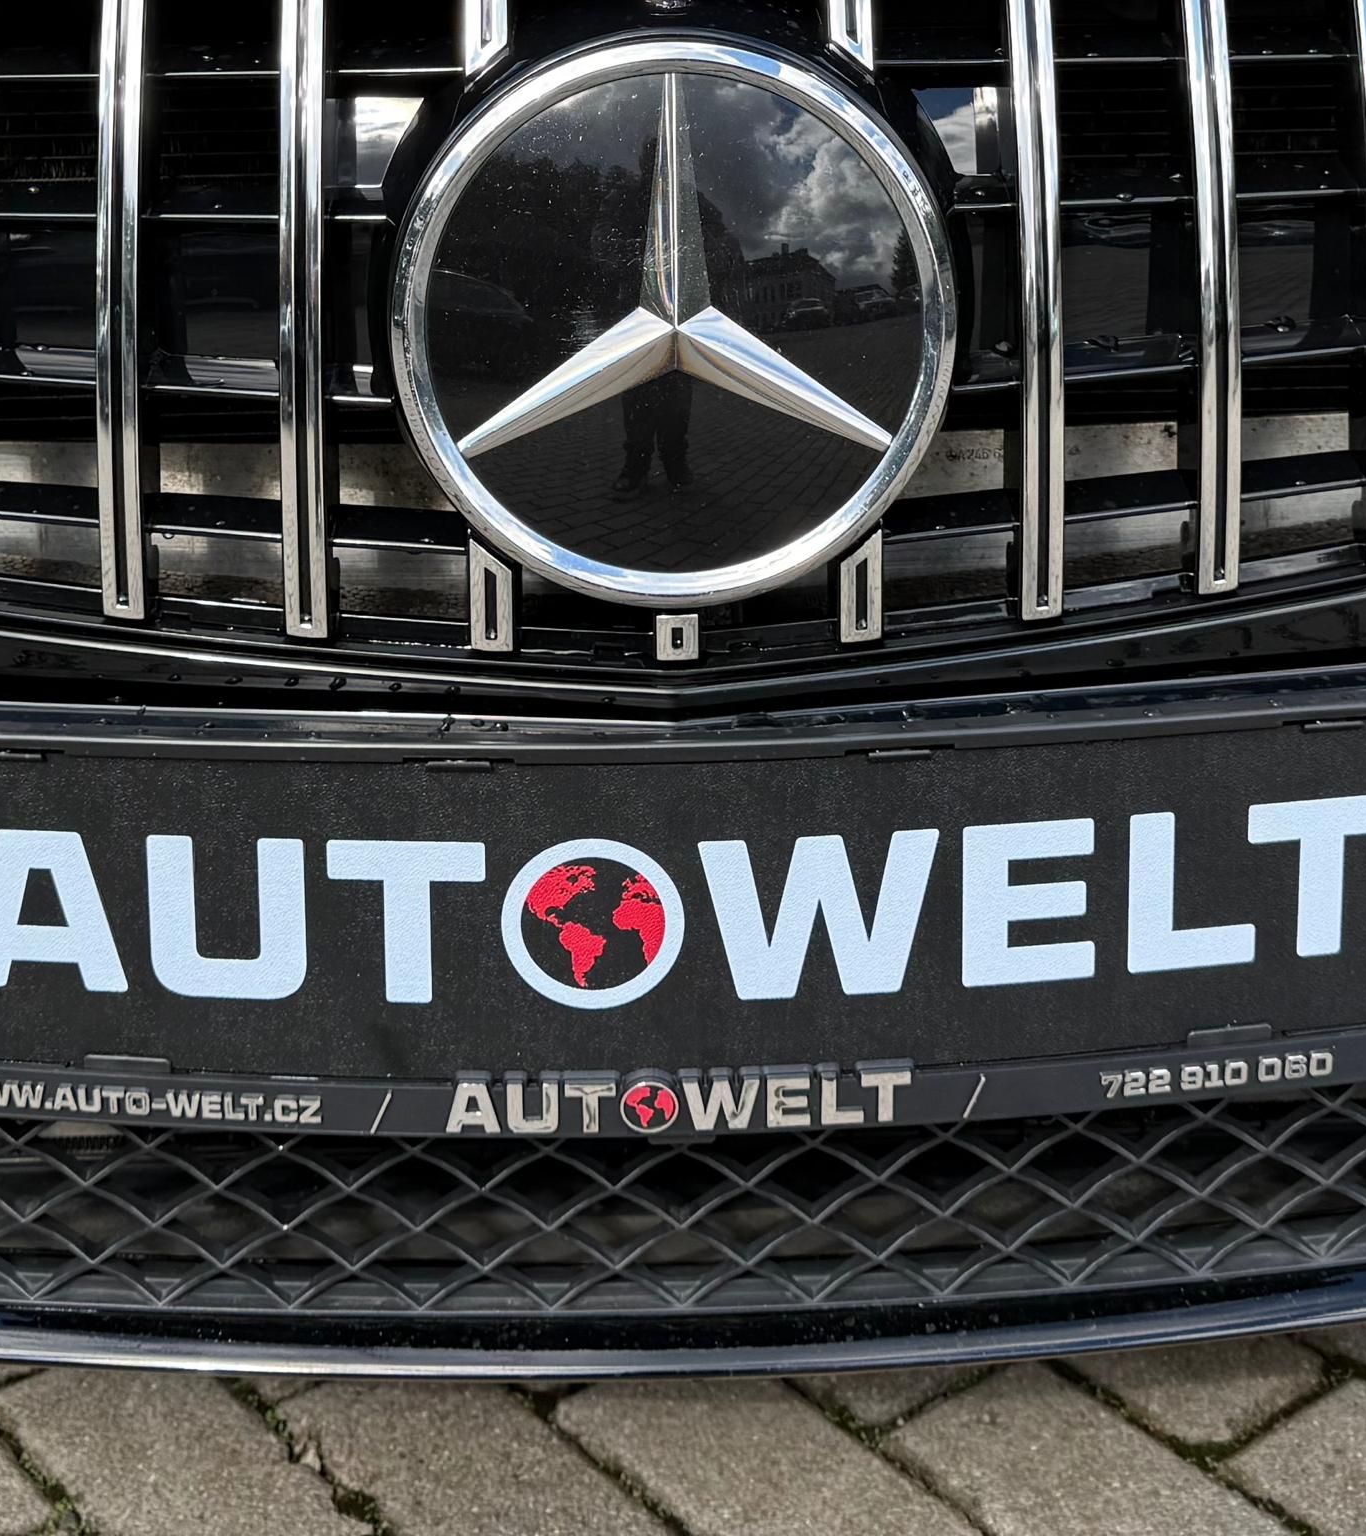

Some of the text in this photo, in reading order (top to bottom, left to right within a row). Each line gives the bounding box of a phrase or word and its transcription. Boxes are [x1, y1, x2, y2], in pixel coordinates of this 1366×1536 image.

[1099, 1070, 1172, 1099] 722
[1180, 1061, 1249, 1091] 910
[1257, 1052, 1334, 1083] 060
